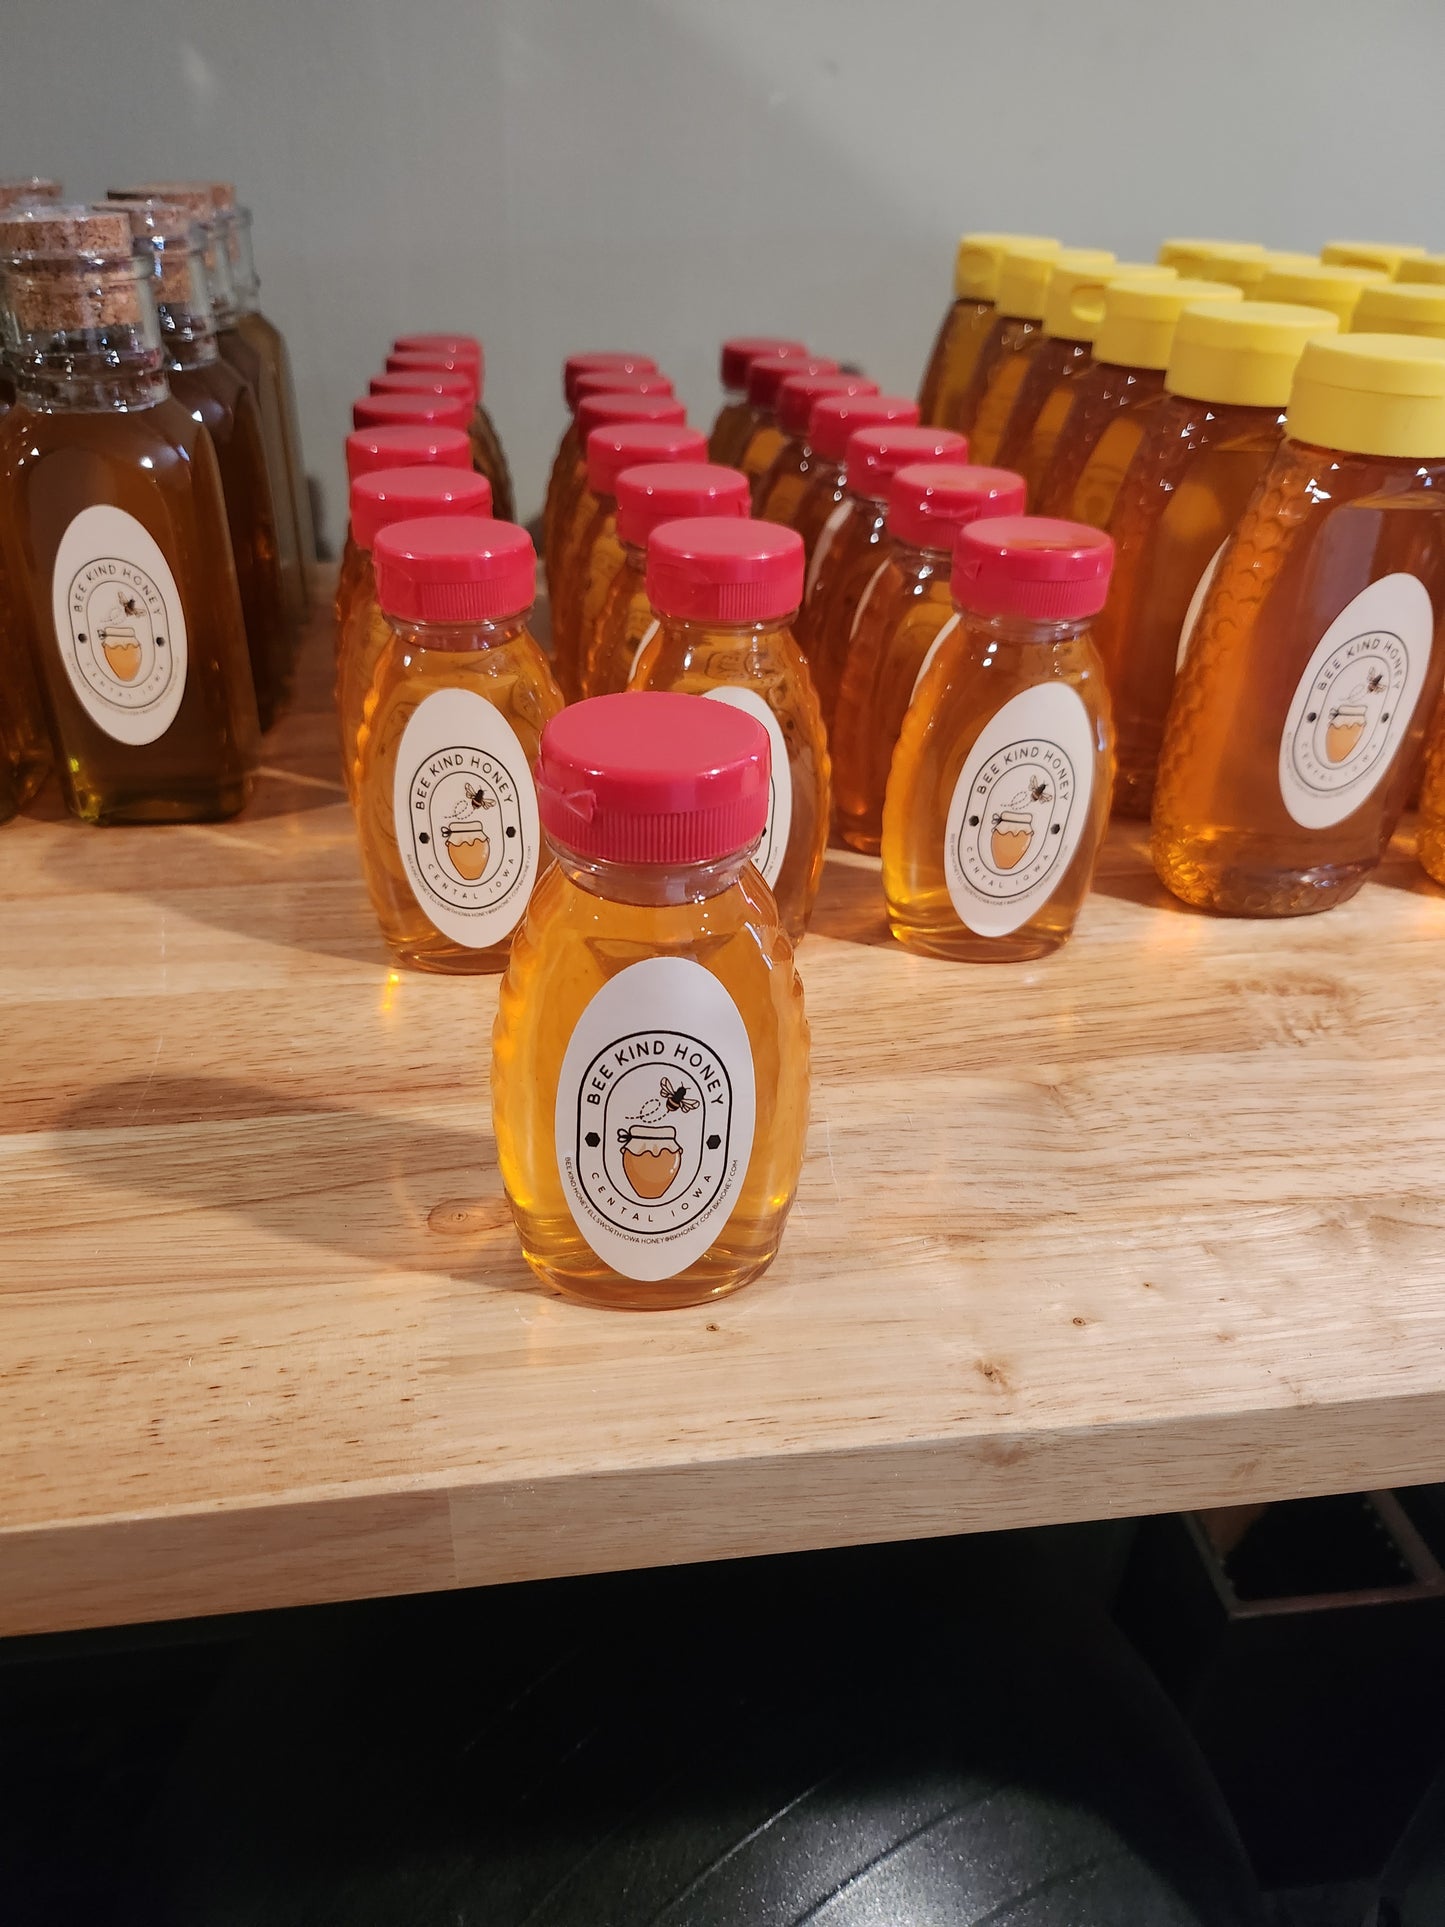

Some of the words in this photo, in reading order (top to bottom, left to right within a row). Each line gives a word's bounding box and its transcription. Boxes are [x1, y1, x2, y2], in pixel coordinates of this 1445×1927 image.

[73, 584, 87, 612] BEE
[86, 564, 116, 581] KIND
[122, 568, 161, 615] HONEY
[1317, 659, 1341, 691] BEE
[1346, 638, 1380, 659] KIND
[415, 777, 431, 810] BEE
[429, 754, 464, 778] KIND
[470, 755, 514, 803] HONEY
[976, 763, 1000, 795] BEE
[1003, 746, 1039, 765] KIND
[1044, 749, 1069, 801] HONEY
[428, 863, 478, 900] CENTAL
[488, 858, 514, 894] IOWA
[587, 1064, 614, 1106] BEE
[614, 1040, 665, 1066] KIND
[673, 1043, 724, 1105] HONEY
[572, 1187, 589, 1210] HONEY
[591, 1172, 654, 1223] CENTAL
[671, 1175, 712, 1217] IOWA
